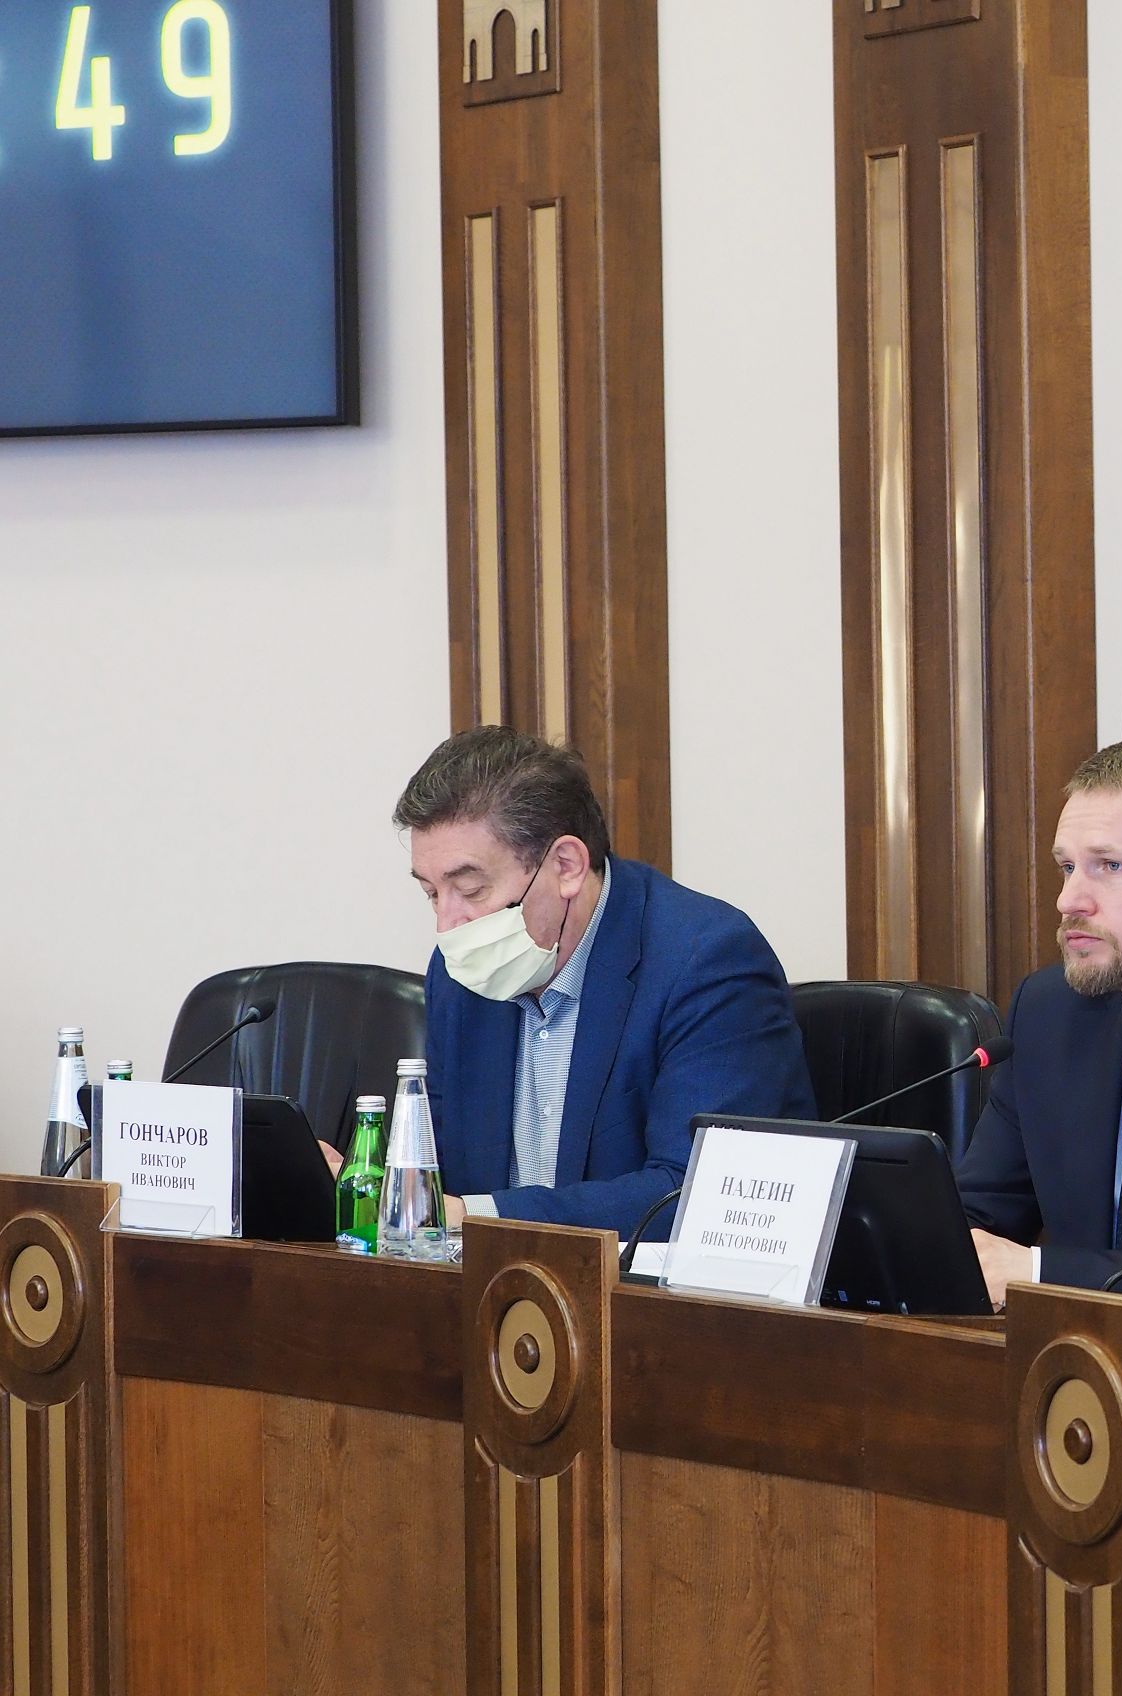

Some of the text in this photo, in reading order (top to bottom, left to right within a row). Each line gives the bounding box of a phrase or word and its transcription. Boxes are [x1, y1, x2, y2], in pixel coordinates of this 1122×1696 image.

[55, 0, 232, 161] 49
[119, 1121, 209, 1147] ГОНЧАРОВ
[140, 1152, 187, 1169] ВИКТОР
[131, 1172, 196, 1191] ИВАНОВИЧ
[719, 1176, 796, 1203] НАДЕИН
[723, 1209, 776, 1229] ВИКТОР
[700, 1230, 788, 1255] ВИКТОРОВИЧ
